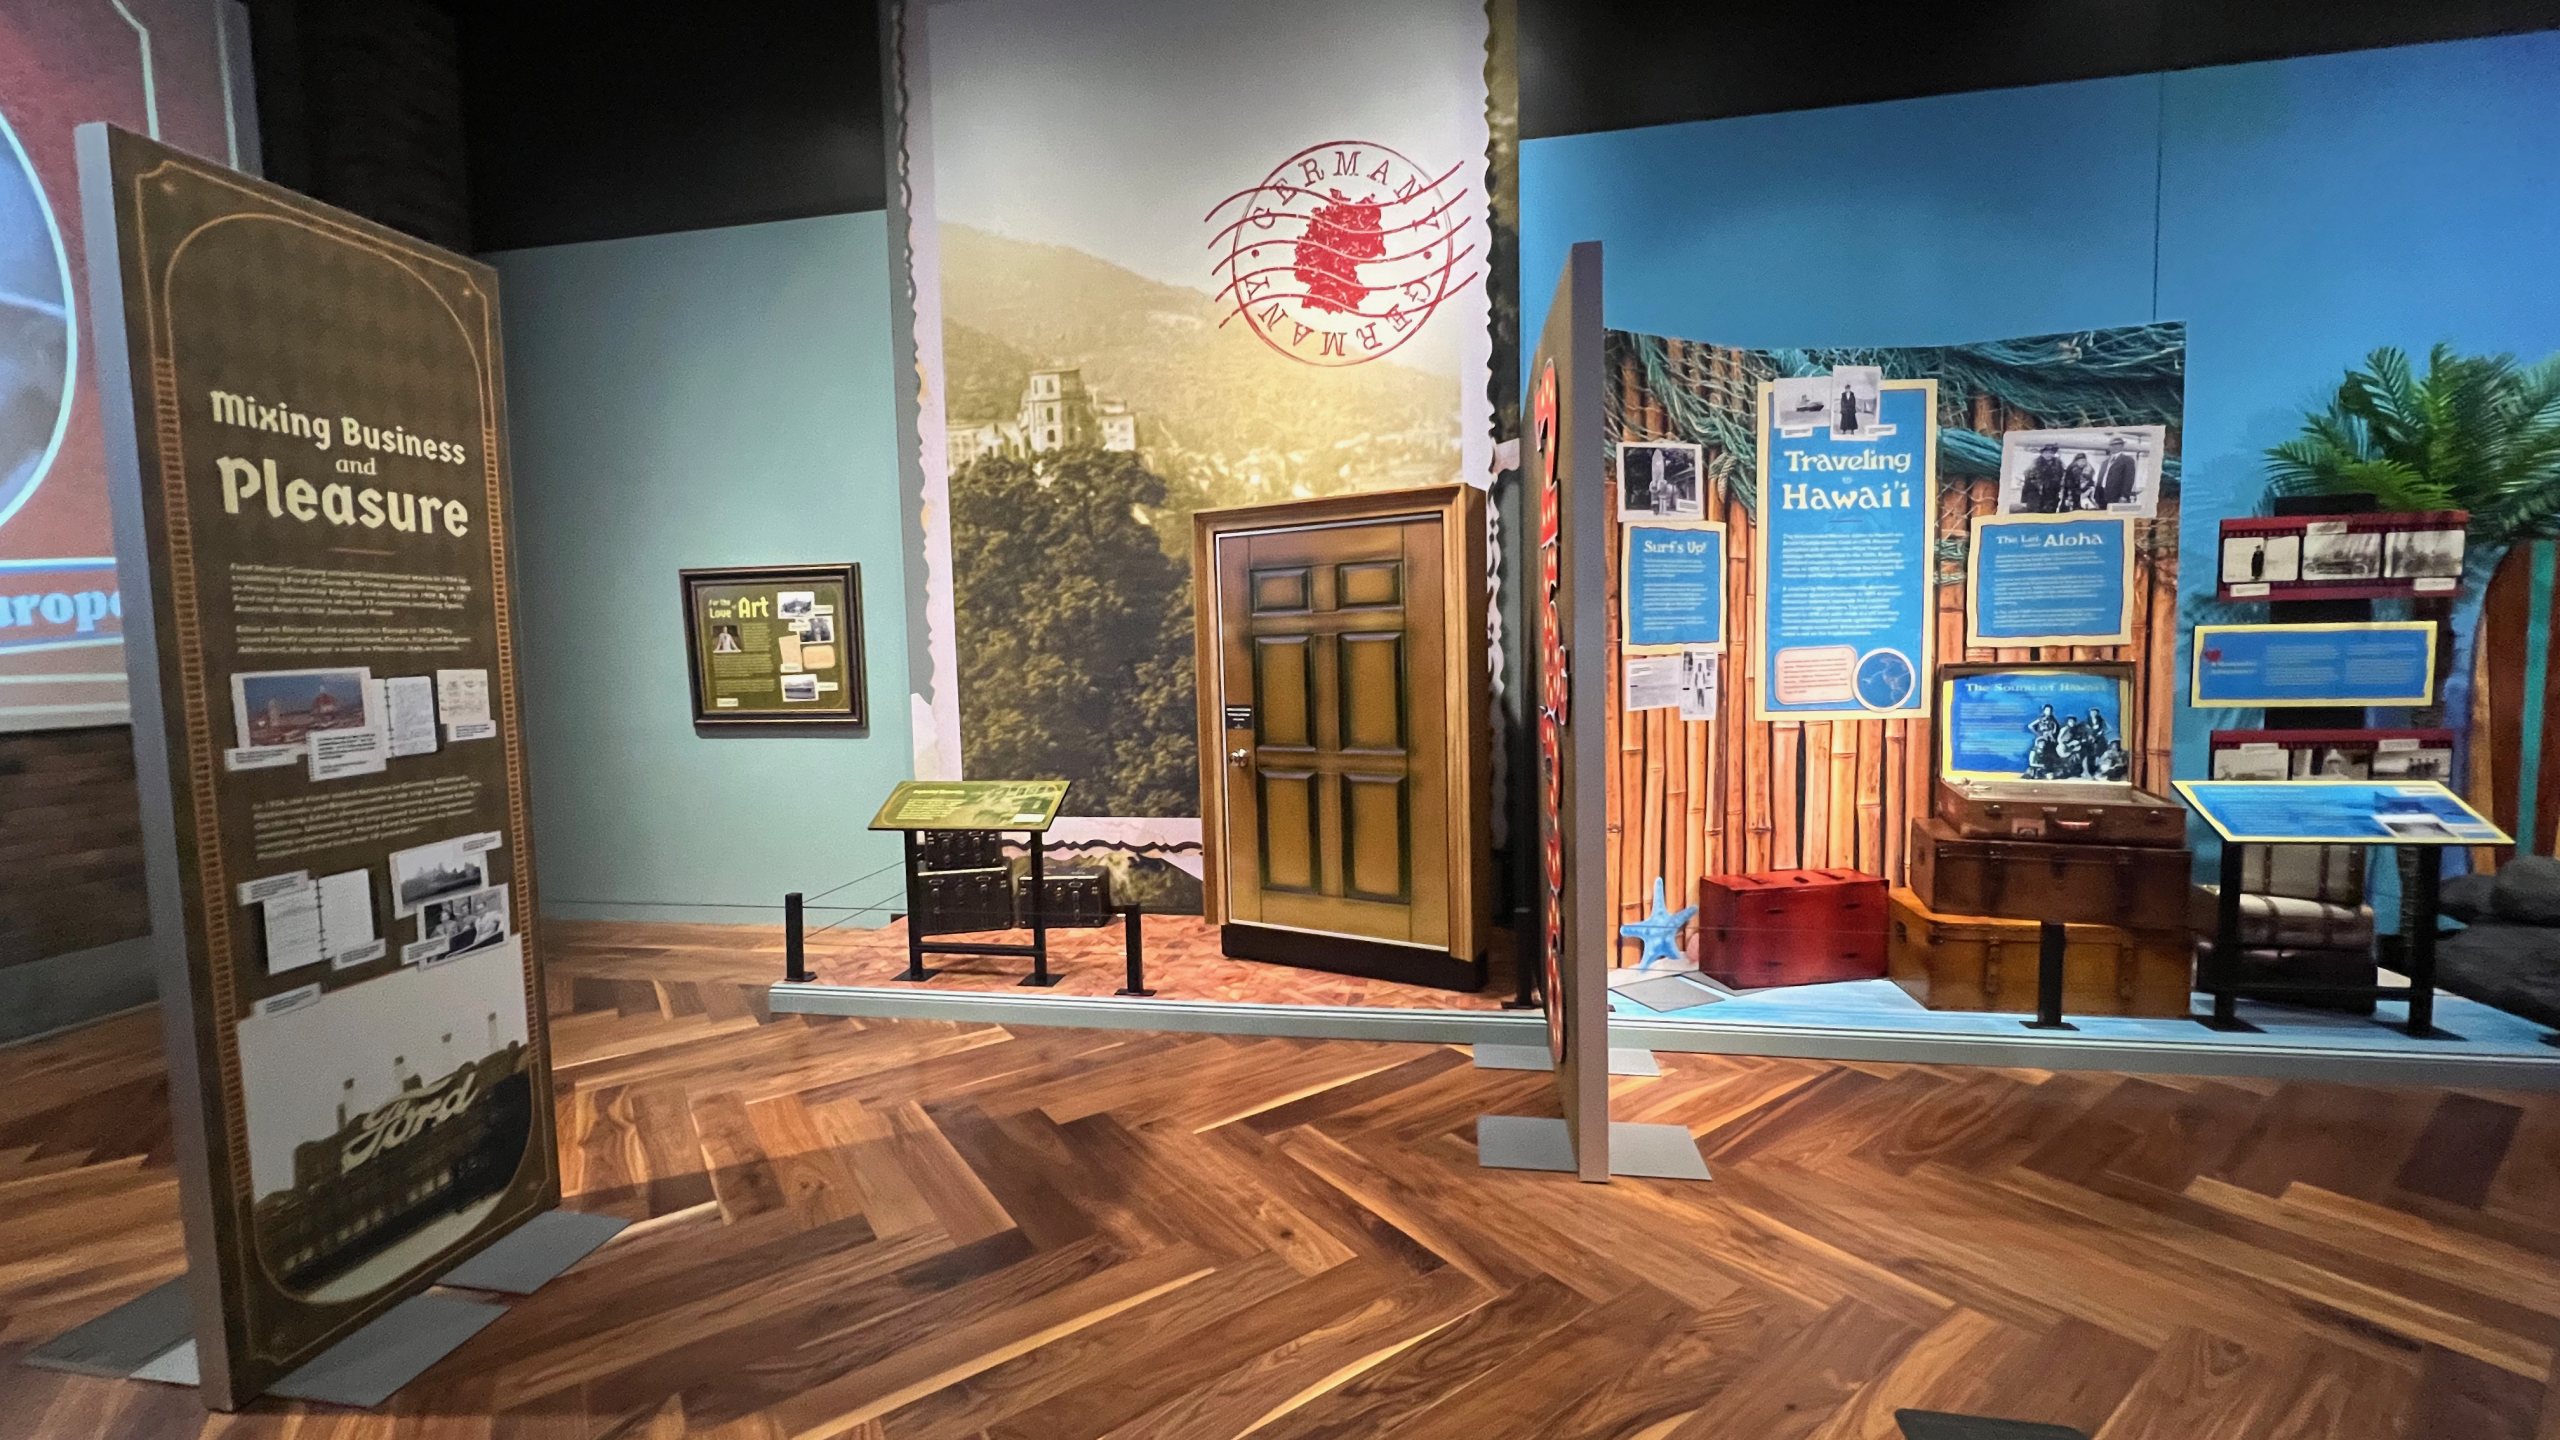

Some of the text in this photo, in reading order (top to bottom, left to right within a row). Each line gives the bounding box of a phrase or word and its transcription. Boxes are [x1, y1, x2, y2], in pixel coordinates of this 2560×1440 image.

[1251, 150, 1441, 232] GERMANY
[1244, 276, 1432, 357] GERMANY
[210, 390, 466, 465] Mixing Business
[335, 457, 378, 476] and
[1783, 448, 1912, 473] Traveling
[216, 455, 469, 538] Pleasure
[2043, 532, 2104, 547] Aloha
[0, 590, 121, 632] rop
[738, 596, 769, 618] Art
[1965, 683, 1990, 692] The
[341, 1073, 480, 1175] Ford
